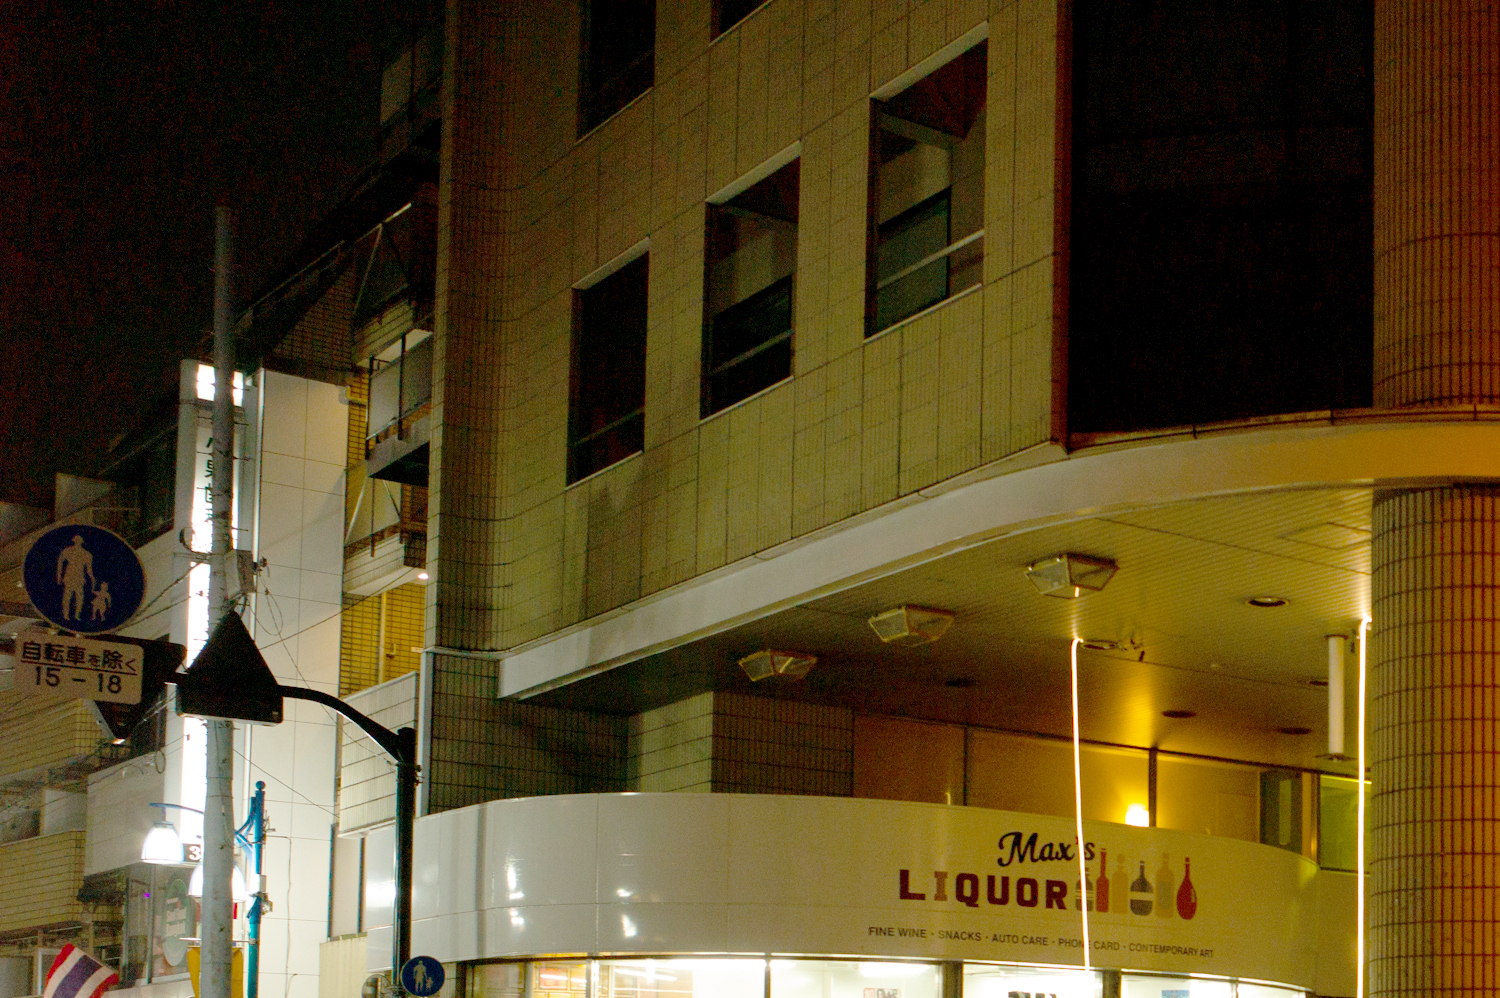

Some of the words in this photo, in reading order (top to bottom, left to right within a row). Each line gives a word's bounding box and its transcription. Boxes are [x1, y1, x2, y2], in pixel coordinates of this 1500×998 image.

[22, 641, 137, 673] 自転車を除く
[997, 831, 1095, 867] Max's
[899, 869, 1067, 910] LIQUOR
[868, 926, 895, 937] FINE
[898, 927, 927, 939] WINE
[938, 929, 982, 942] SNACKS
[992, 933, 1019, 944] AUTO
[1021, 935, 1049, 946] CARE
[1094, 940, 1120, 951] CARD
[1129, 942, 1198, 957] CONTEMPORARY
[1199, 947, 1213, 958] ART
